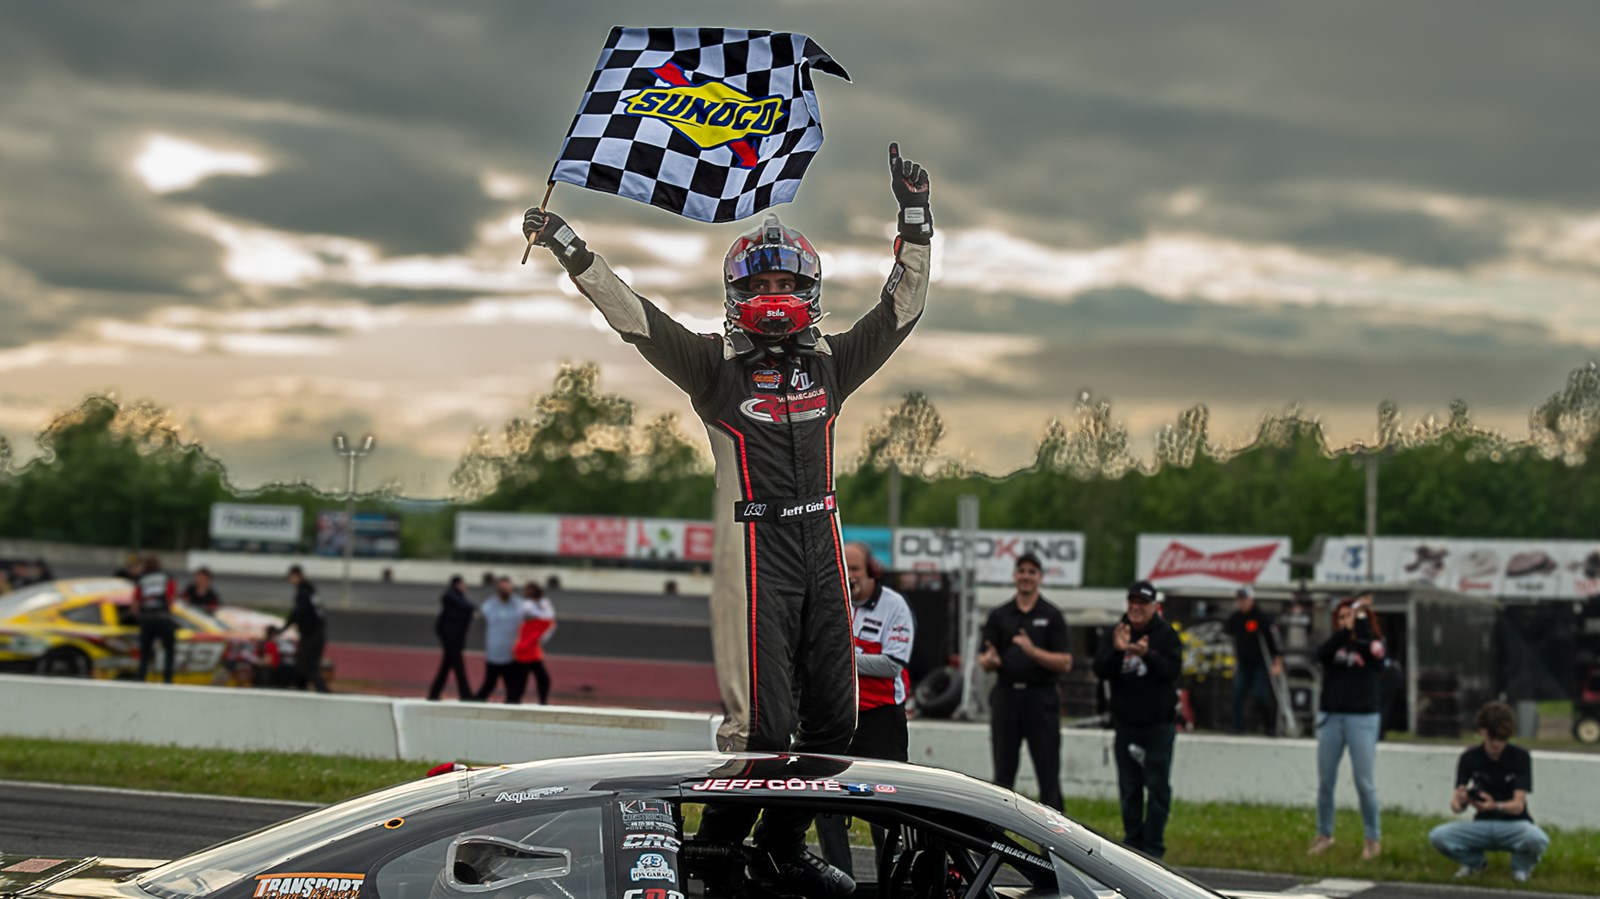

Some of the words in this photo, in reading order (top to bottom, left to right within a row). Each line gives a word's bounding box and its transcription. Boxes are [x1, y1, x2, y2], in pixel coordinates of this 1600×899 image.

[633, 92, 778, 131] SUNOCO
[766, 309, 785, 317] Stilo
[780, 506, 804, 517] Jeff
[805, 501, 825, 513] Côté
[692, 779, 766, 791] JEFF
[765, 777, 842, 791] CÔTÉ
[990, 841, 1004, 851] BIG
[1004, 846, 1028, 861] BLACK
[640, 855, 663, 868] 43
[253, 878, 365, 899] TRANSPORT
